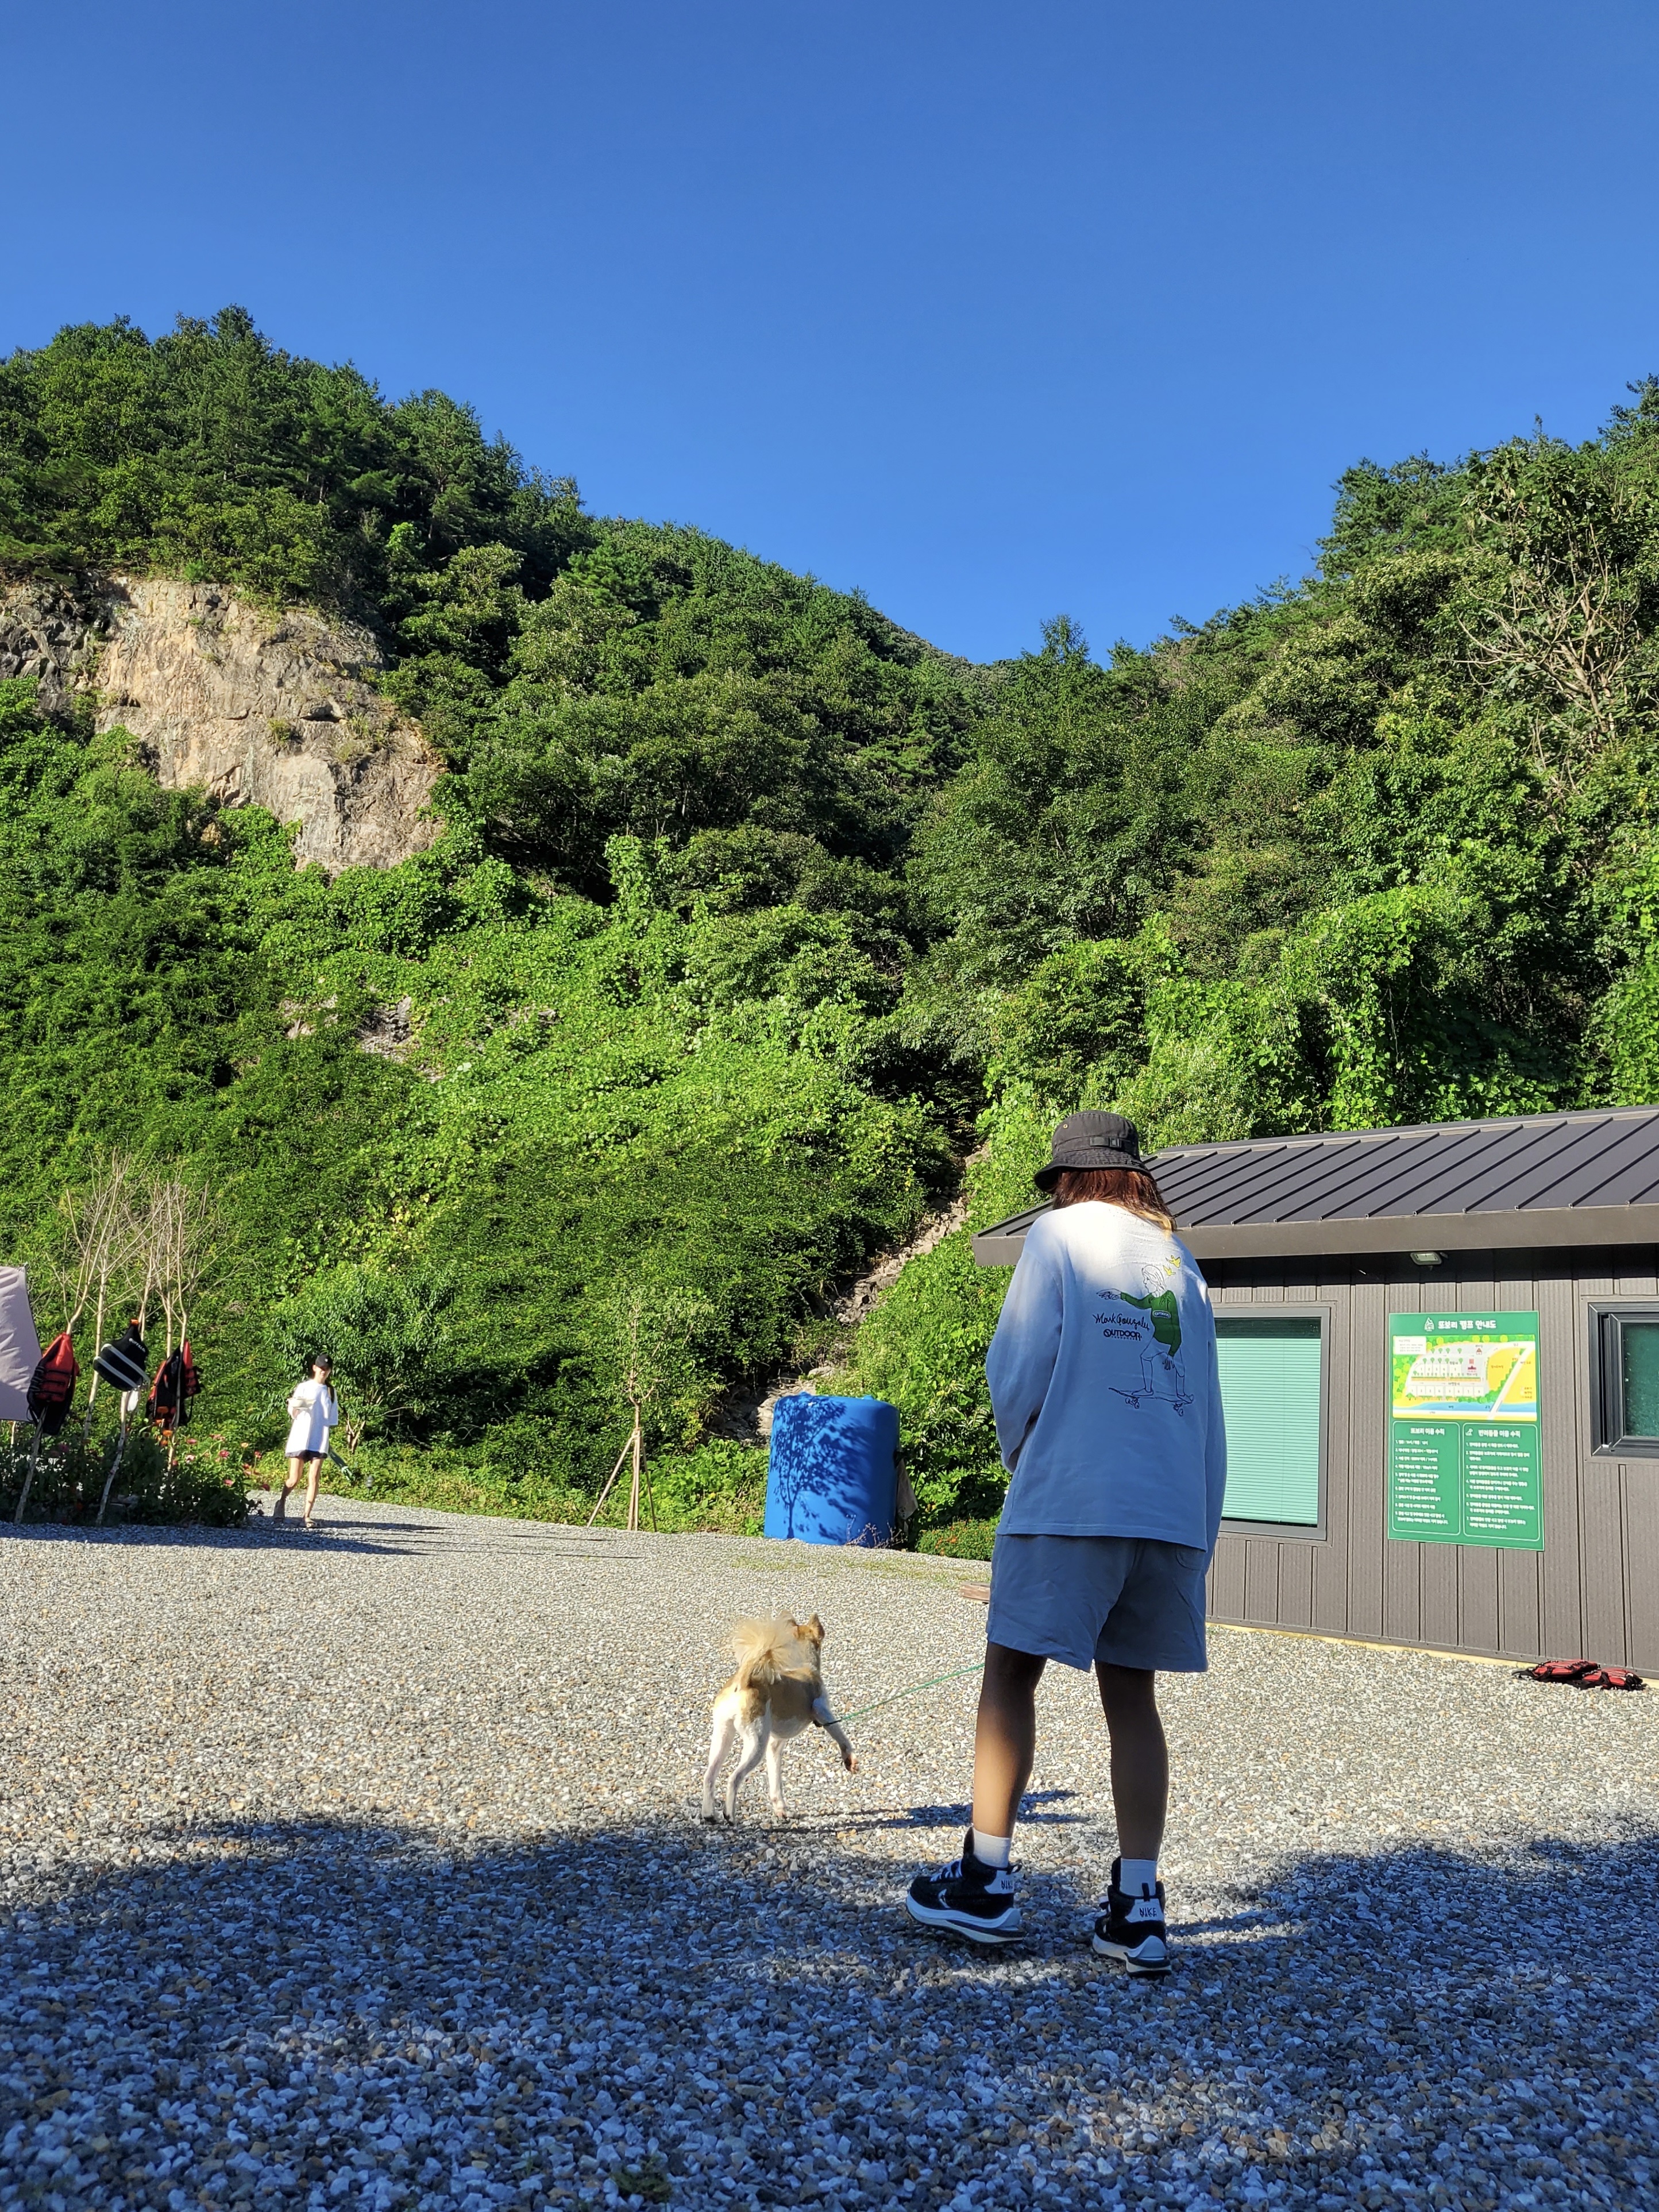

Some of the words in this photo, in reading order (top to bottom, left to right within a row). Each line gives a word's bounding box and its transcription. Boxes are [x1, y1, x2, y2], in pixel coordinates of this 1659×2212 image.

[1093, 1312, 1116, 1324] Mark
[1438, 1321, 1458, 1329] 또보리
[1459, 1321, 1474, 1330] 캠프
[1475, 1320, 1497, 1330] 안내도
[1104, 1329, 1141, 1341] OUTDOOR
[1139, 1908, 1156, 1917] NIKE
